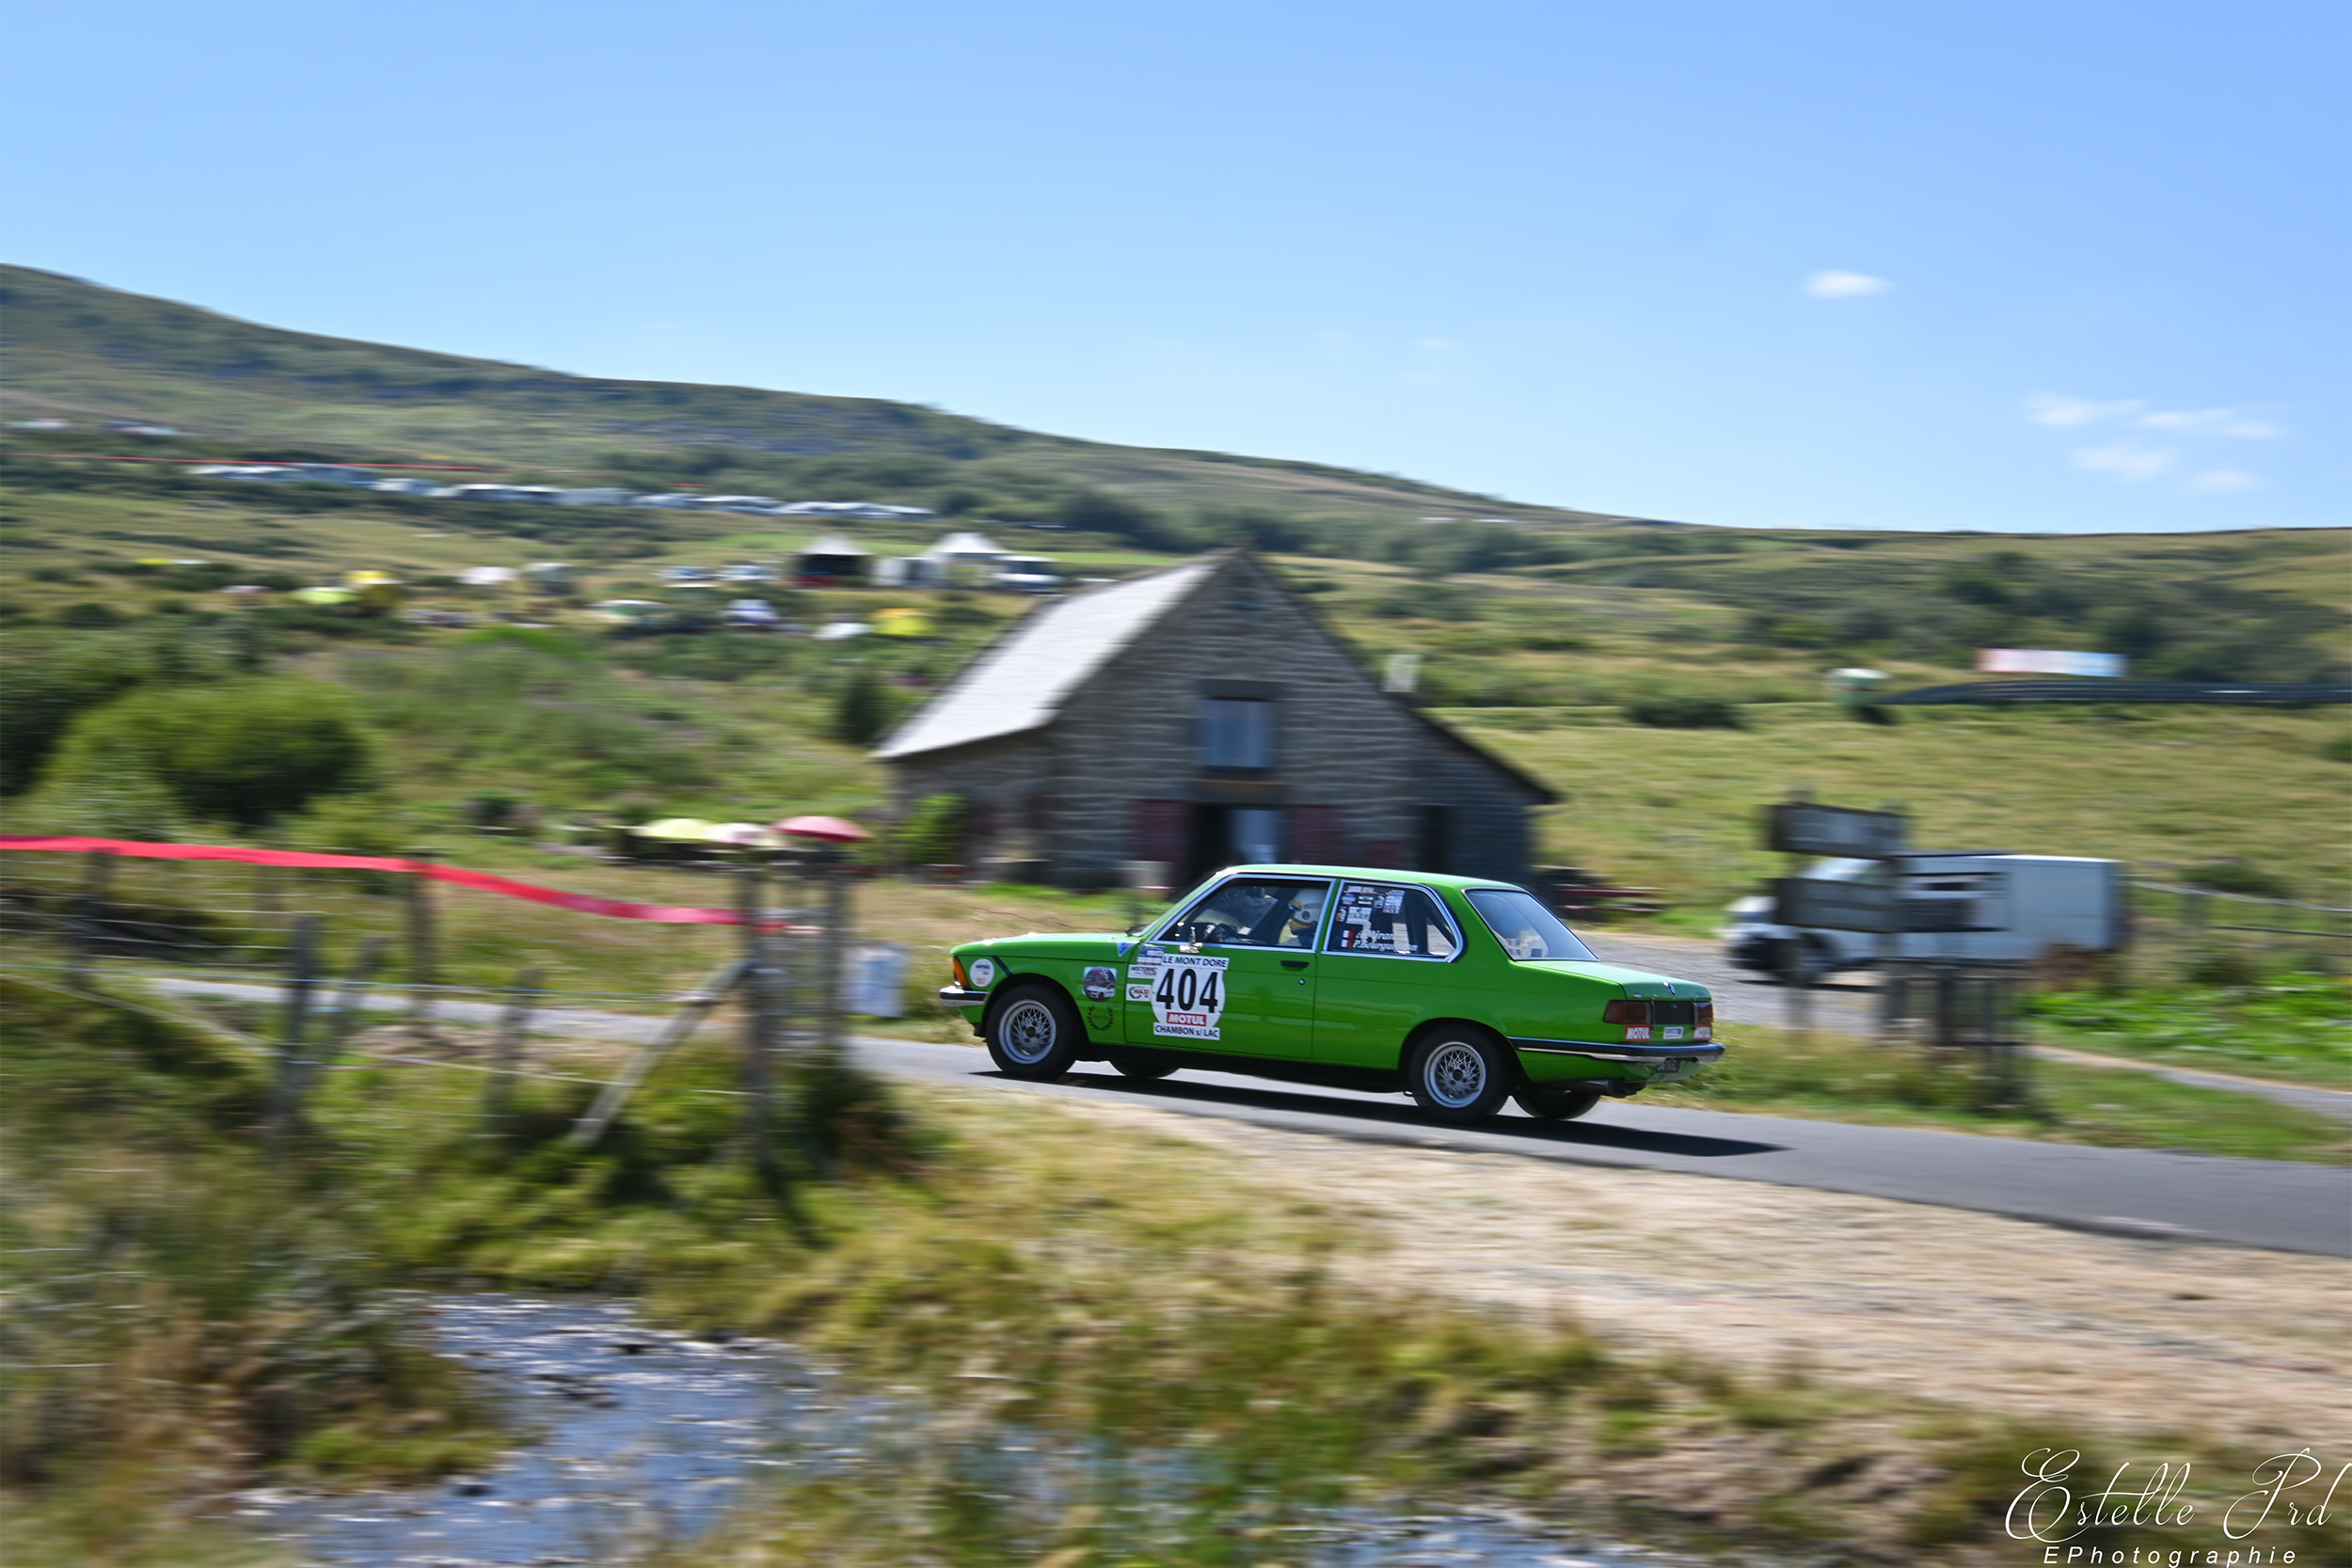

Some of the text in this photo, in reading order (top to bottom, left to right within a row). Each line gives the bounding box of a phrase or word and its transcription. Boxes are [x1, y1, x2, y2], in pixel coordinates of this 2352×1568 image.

[1163, 956, 1174, 964] LE
[1175, 957, 1201, 966] MONT
[1202, 958, 1227, 968] DORE
[1155, 968, 1218, 1014] 404
[1168, 1014, 1206, 1025] MOTUL
[1155, 1024, 1194, 1036] CHAMBON
[1203, 1029, 1218, 1037] LAC
[1626, 1027, 1650, 1039] MOTUL
